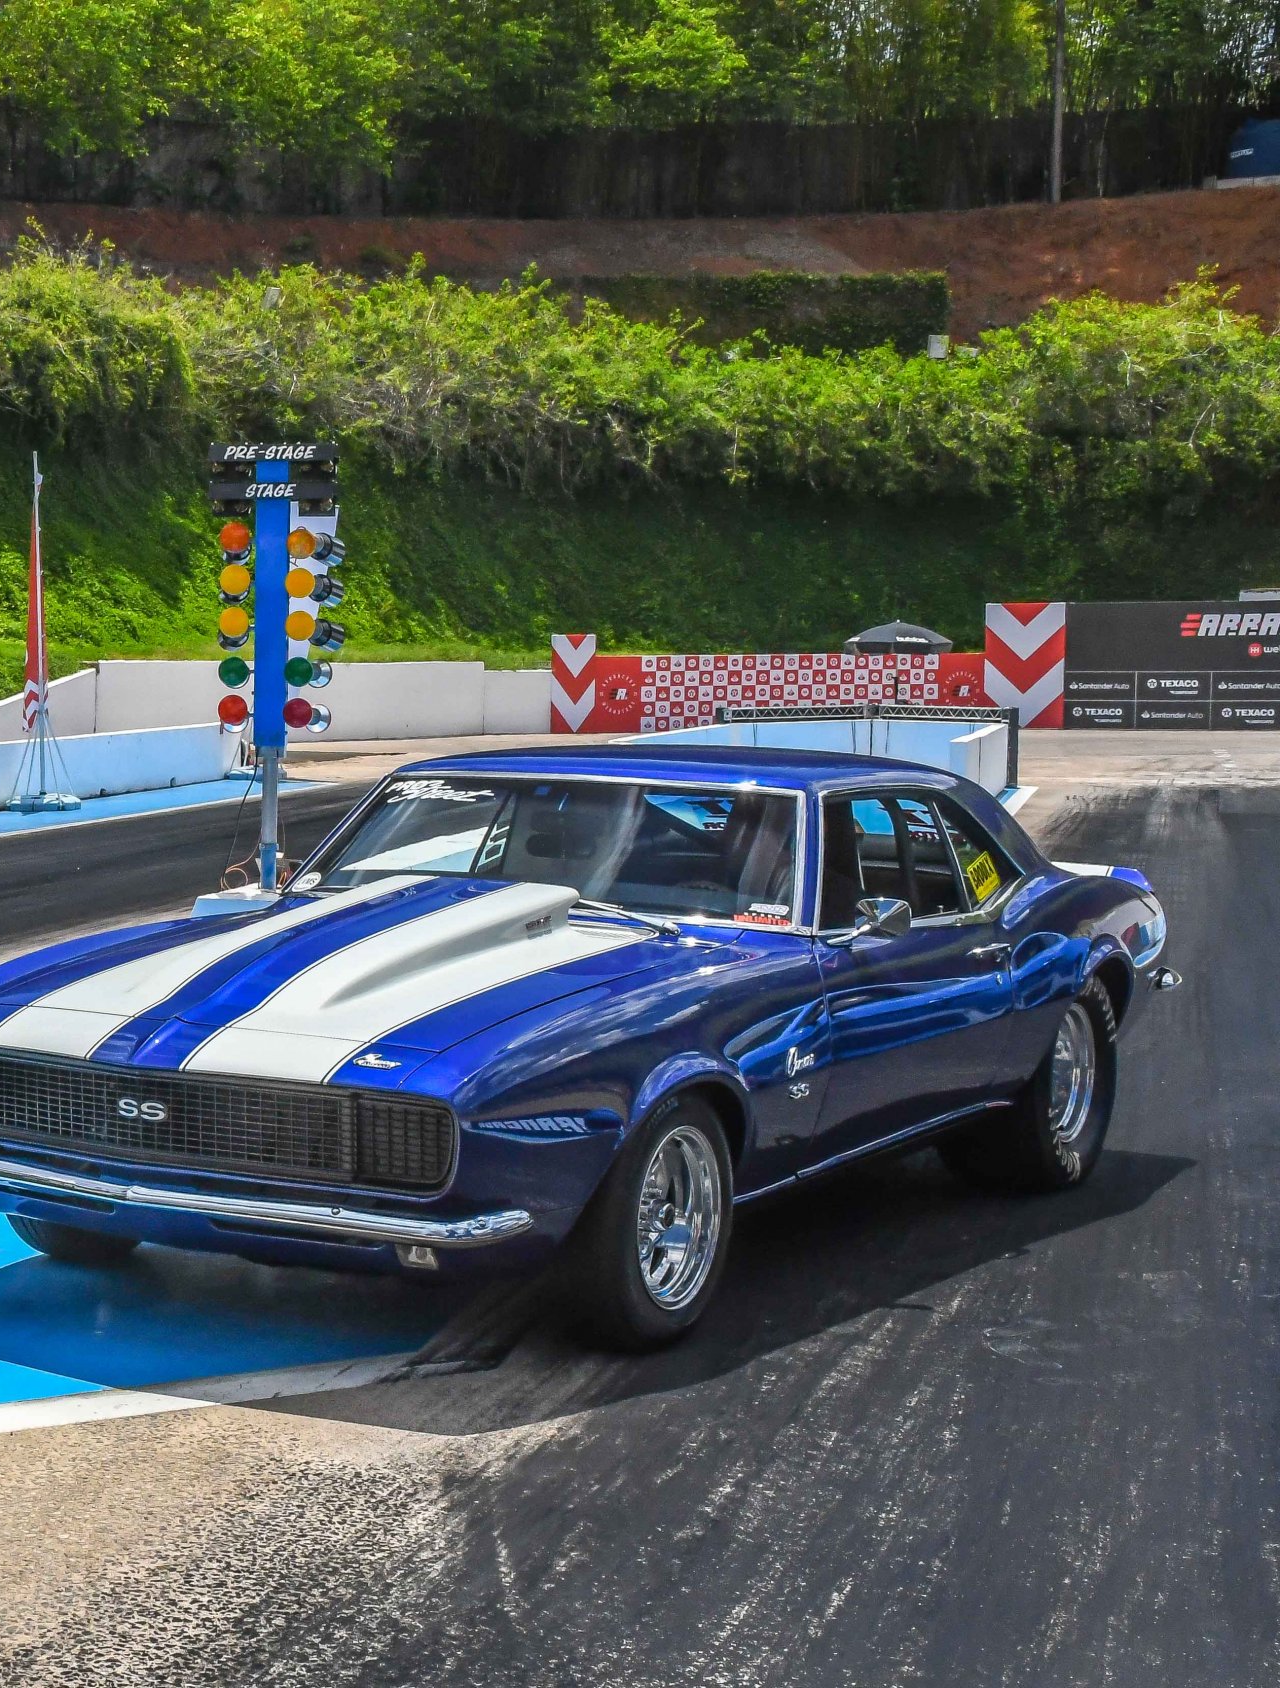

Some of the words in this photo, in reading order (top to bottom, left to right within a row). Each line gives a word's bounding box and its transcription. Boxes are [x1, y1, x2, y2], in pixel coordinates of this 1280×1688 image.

[223, 445, 317, 460] PRE-STAGE
[245, 483, 297, 498] STAGE
[1078, 682, 1113, 690] Santander
[1159, 679, 1199, 688] TEXACO
[1227, 682, 1264, 690] Santander
[1084, 707, 1123, 716] TEXACO
[1150, 711, 1187, 719] Santander
[1187, 711, 1204, 719] Auto
[1234, 708, 1275, 717] TEXACO
[118, 1098, 166, 1121] SS
